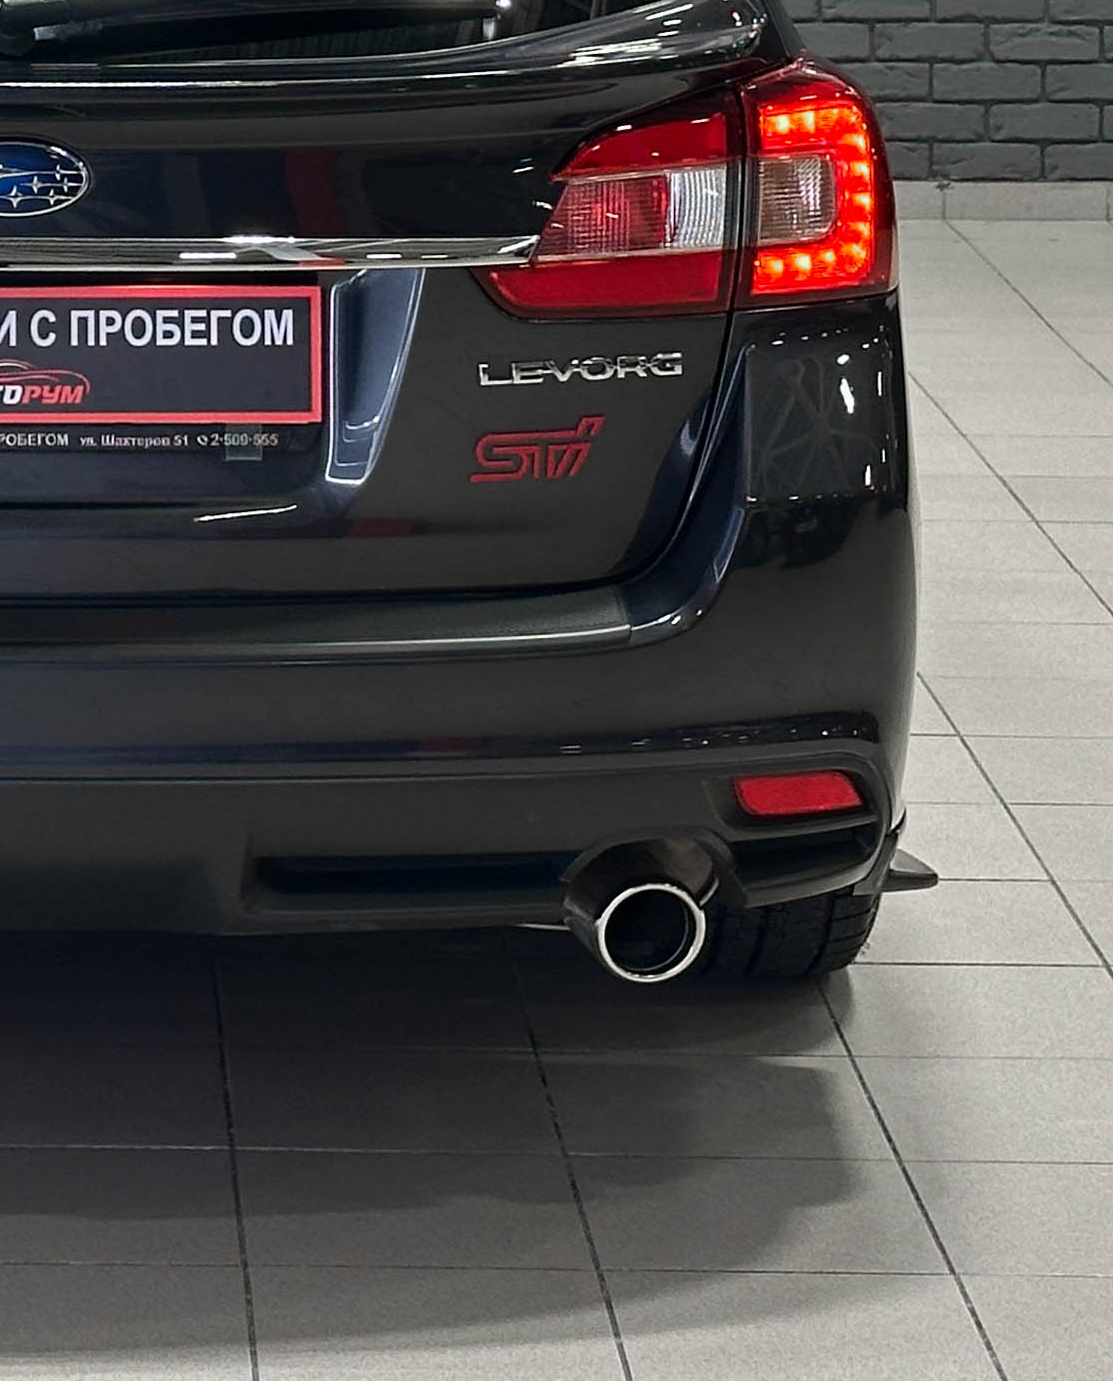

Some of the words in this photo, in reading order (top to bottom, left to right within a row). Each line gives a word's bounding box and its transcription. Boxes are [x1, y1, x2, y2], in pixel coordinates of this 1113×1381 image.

[30, 308, 57, 348] С
[70, 308, 294, 347] ПРОБЕГОМ
[478, 352, 683, 386] LEVORG
[80, 436, 97, 447] ул.
[173, 434, 188, 447] 51
